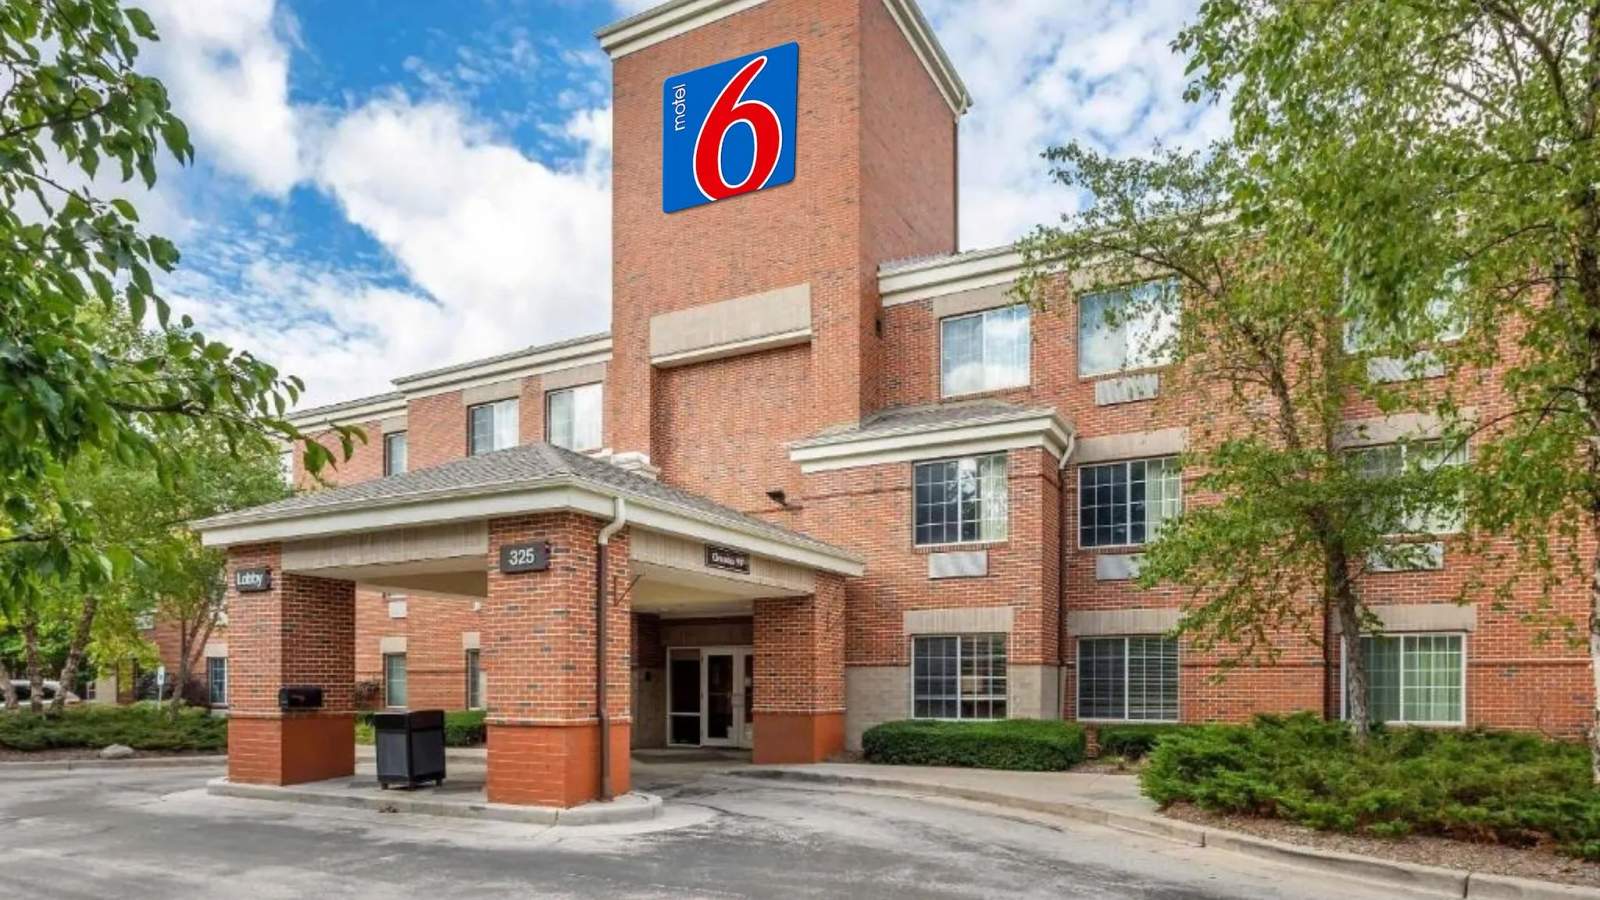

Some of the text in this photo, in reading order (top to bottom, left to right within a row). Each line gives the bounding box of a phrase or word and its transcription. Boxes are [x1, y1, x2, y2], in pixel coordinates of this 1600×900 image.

[672, 83, 687, 132] motel
[692, 55, 783, 202] 6
[509, 547, 535, 566] 325
[236, 571, 263, 588] Lobby
